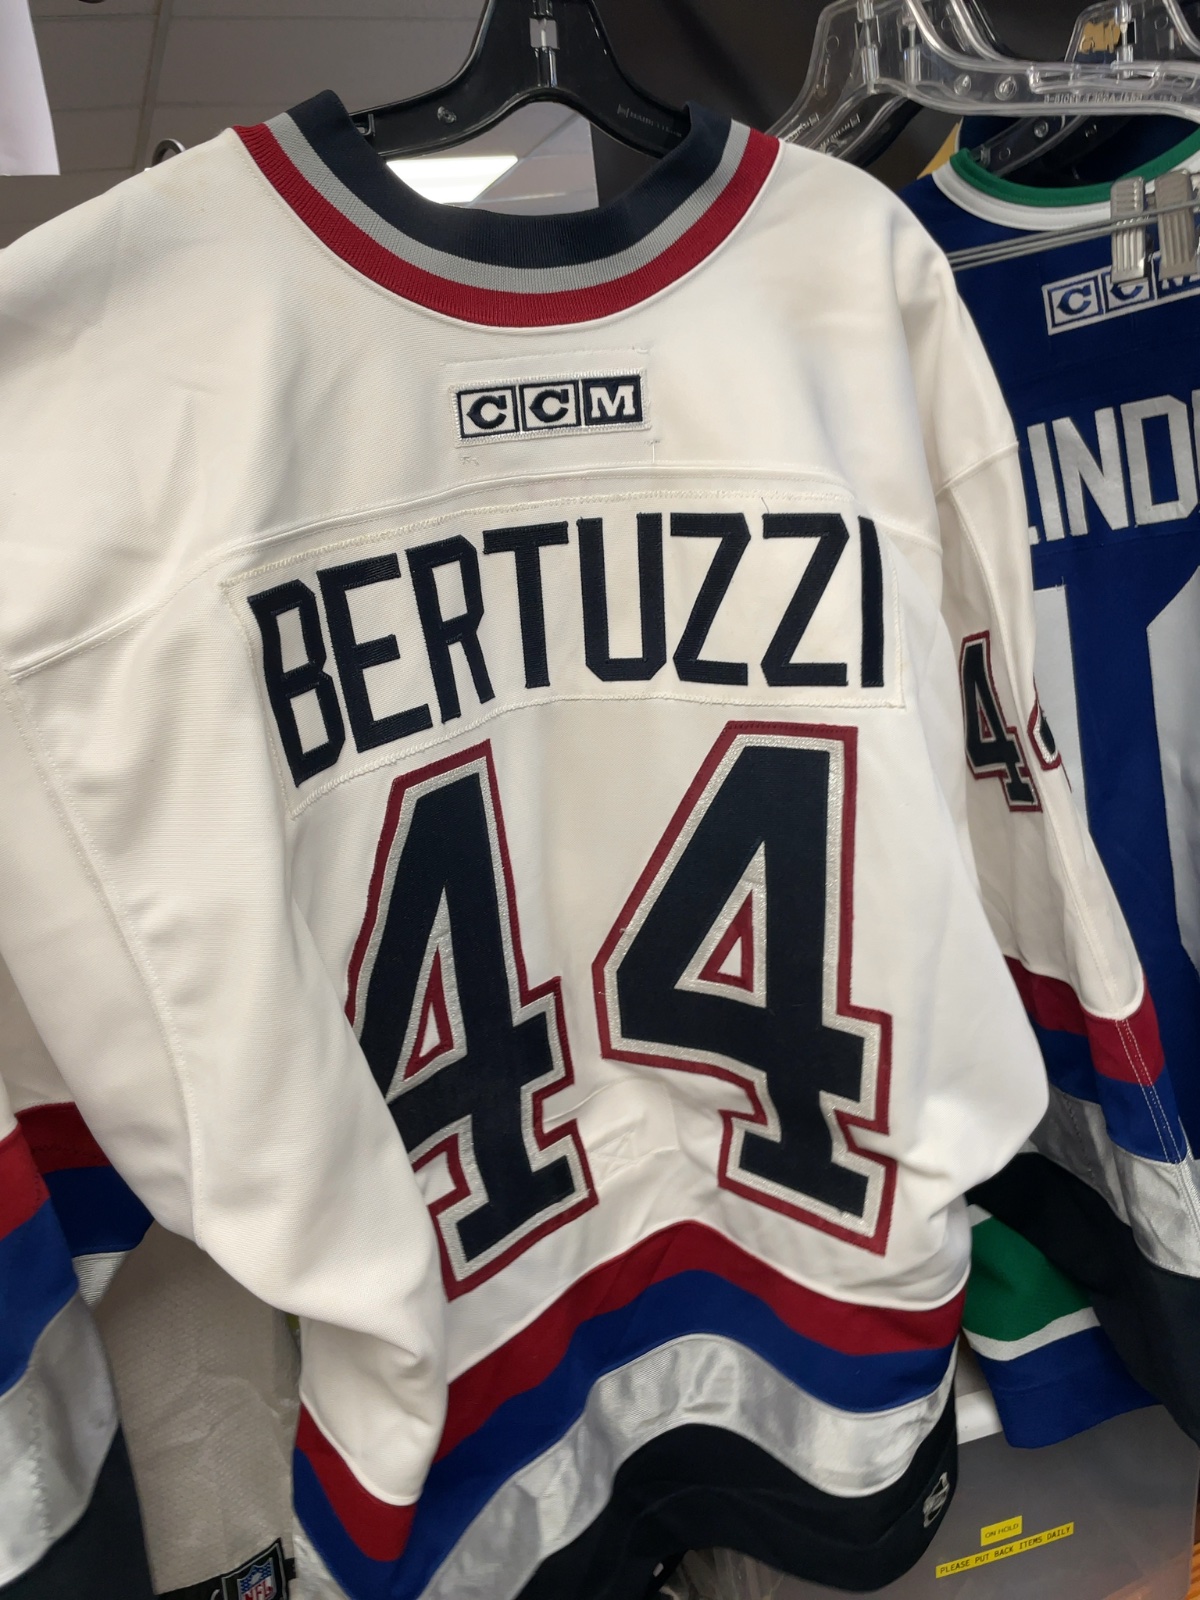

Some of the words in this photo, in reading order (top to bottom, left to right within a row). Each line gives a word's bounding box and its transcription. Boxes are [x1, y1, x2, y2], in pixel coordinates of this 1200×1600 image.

[466, 384, 636, 430] CCM
[247, 513, 885, 787] BERTUZZI
[344, 719, 899, 1303] 44
[940, 1560, 971, 1575] PLEASE
[974, 1554, 990, 1564] PUT
[994, 1545, 1014, 1558] BACK
[1019, 1536, 1043, 1550] ITEMS
[1046, 1526, 1071, 1541] DAILY
[997, 1523, 1019, 1535] HOLD
